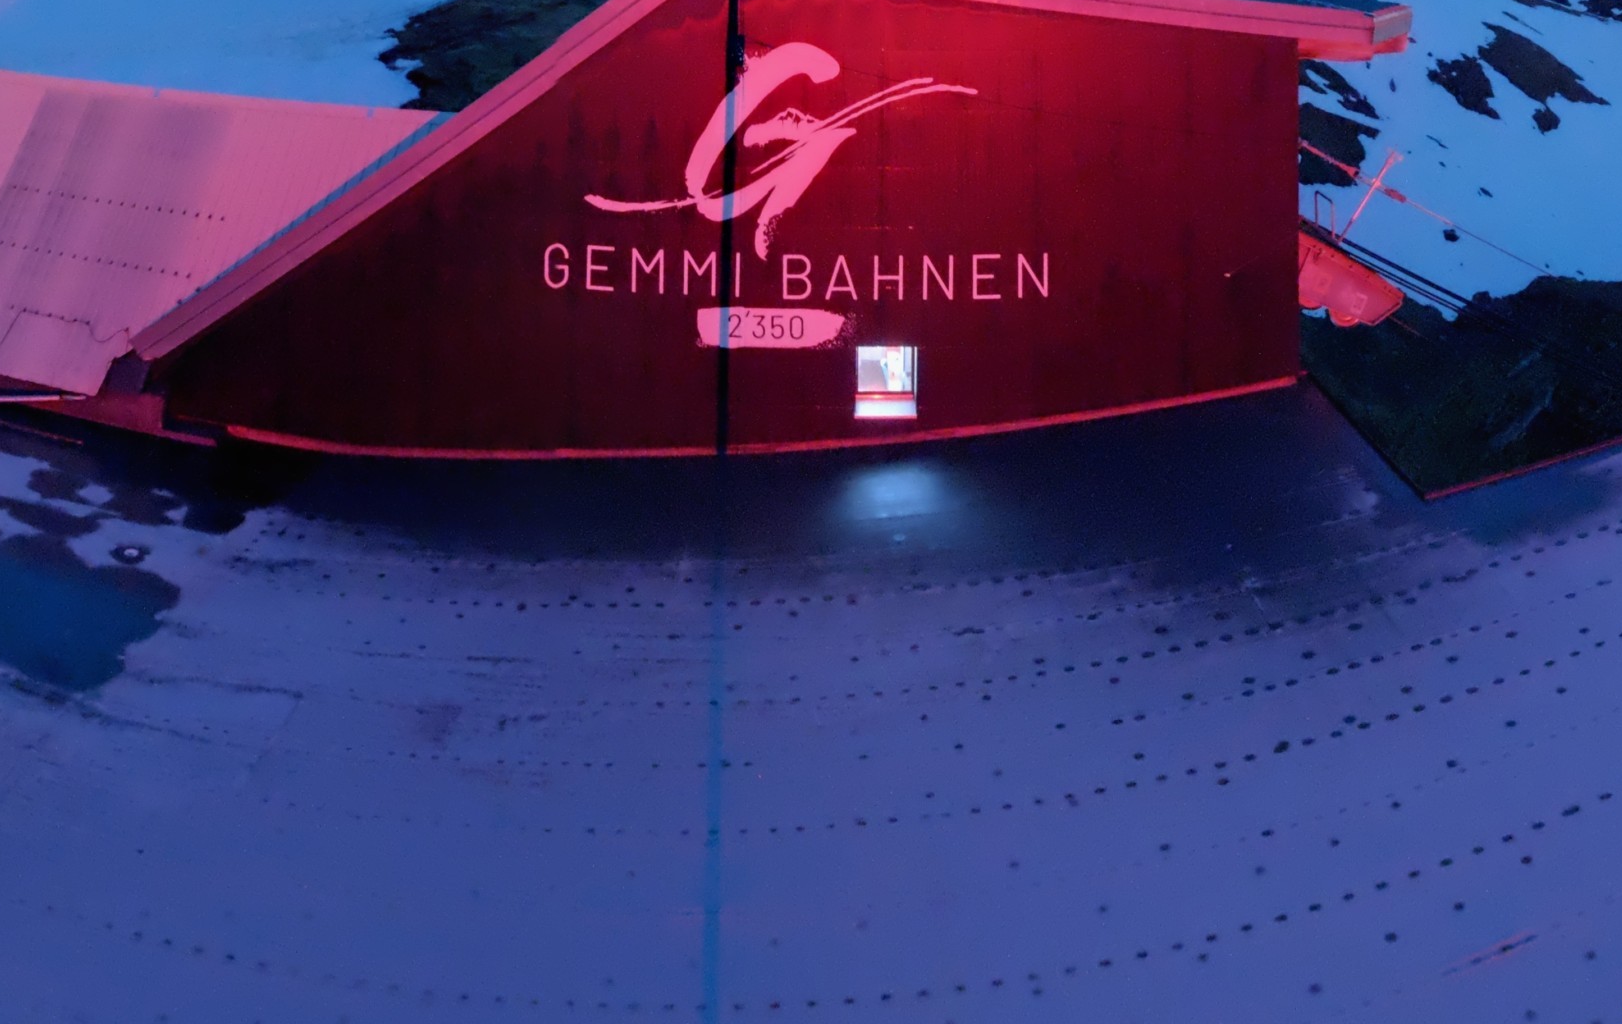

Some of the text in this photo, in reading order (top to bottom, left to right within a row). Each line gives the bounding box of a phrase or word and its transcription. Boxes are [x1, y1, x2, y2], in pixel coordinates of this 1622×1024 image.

[543, 243, 1049, 301] GEMMI BAHNEN
[727, 311, 805, 341] 2'350
